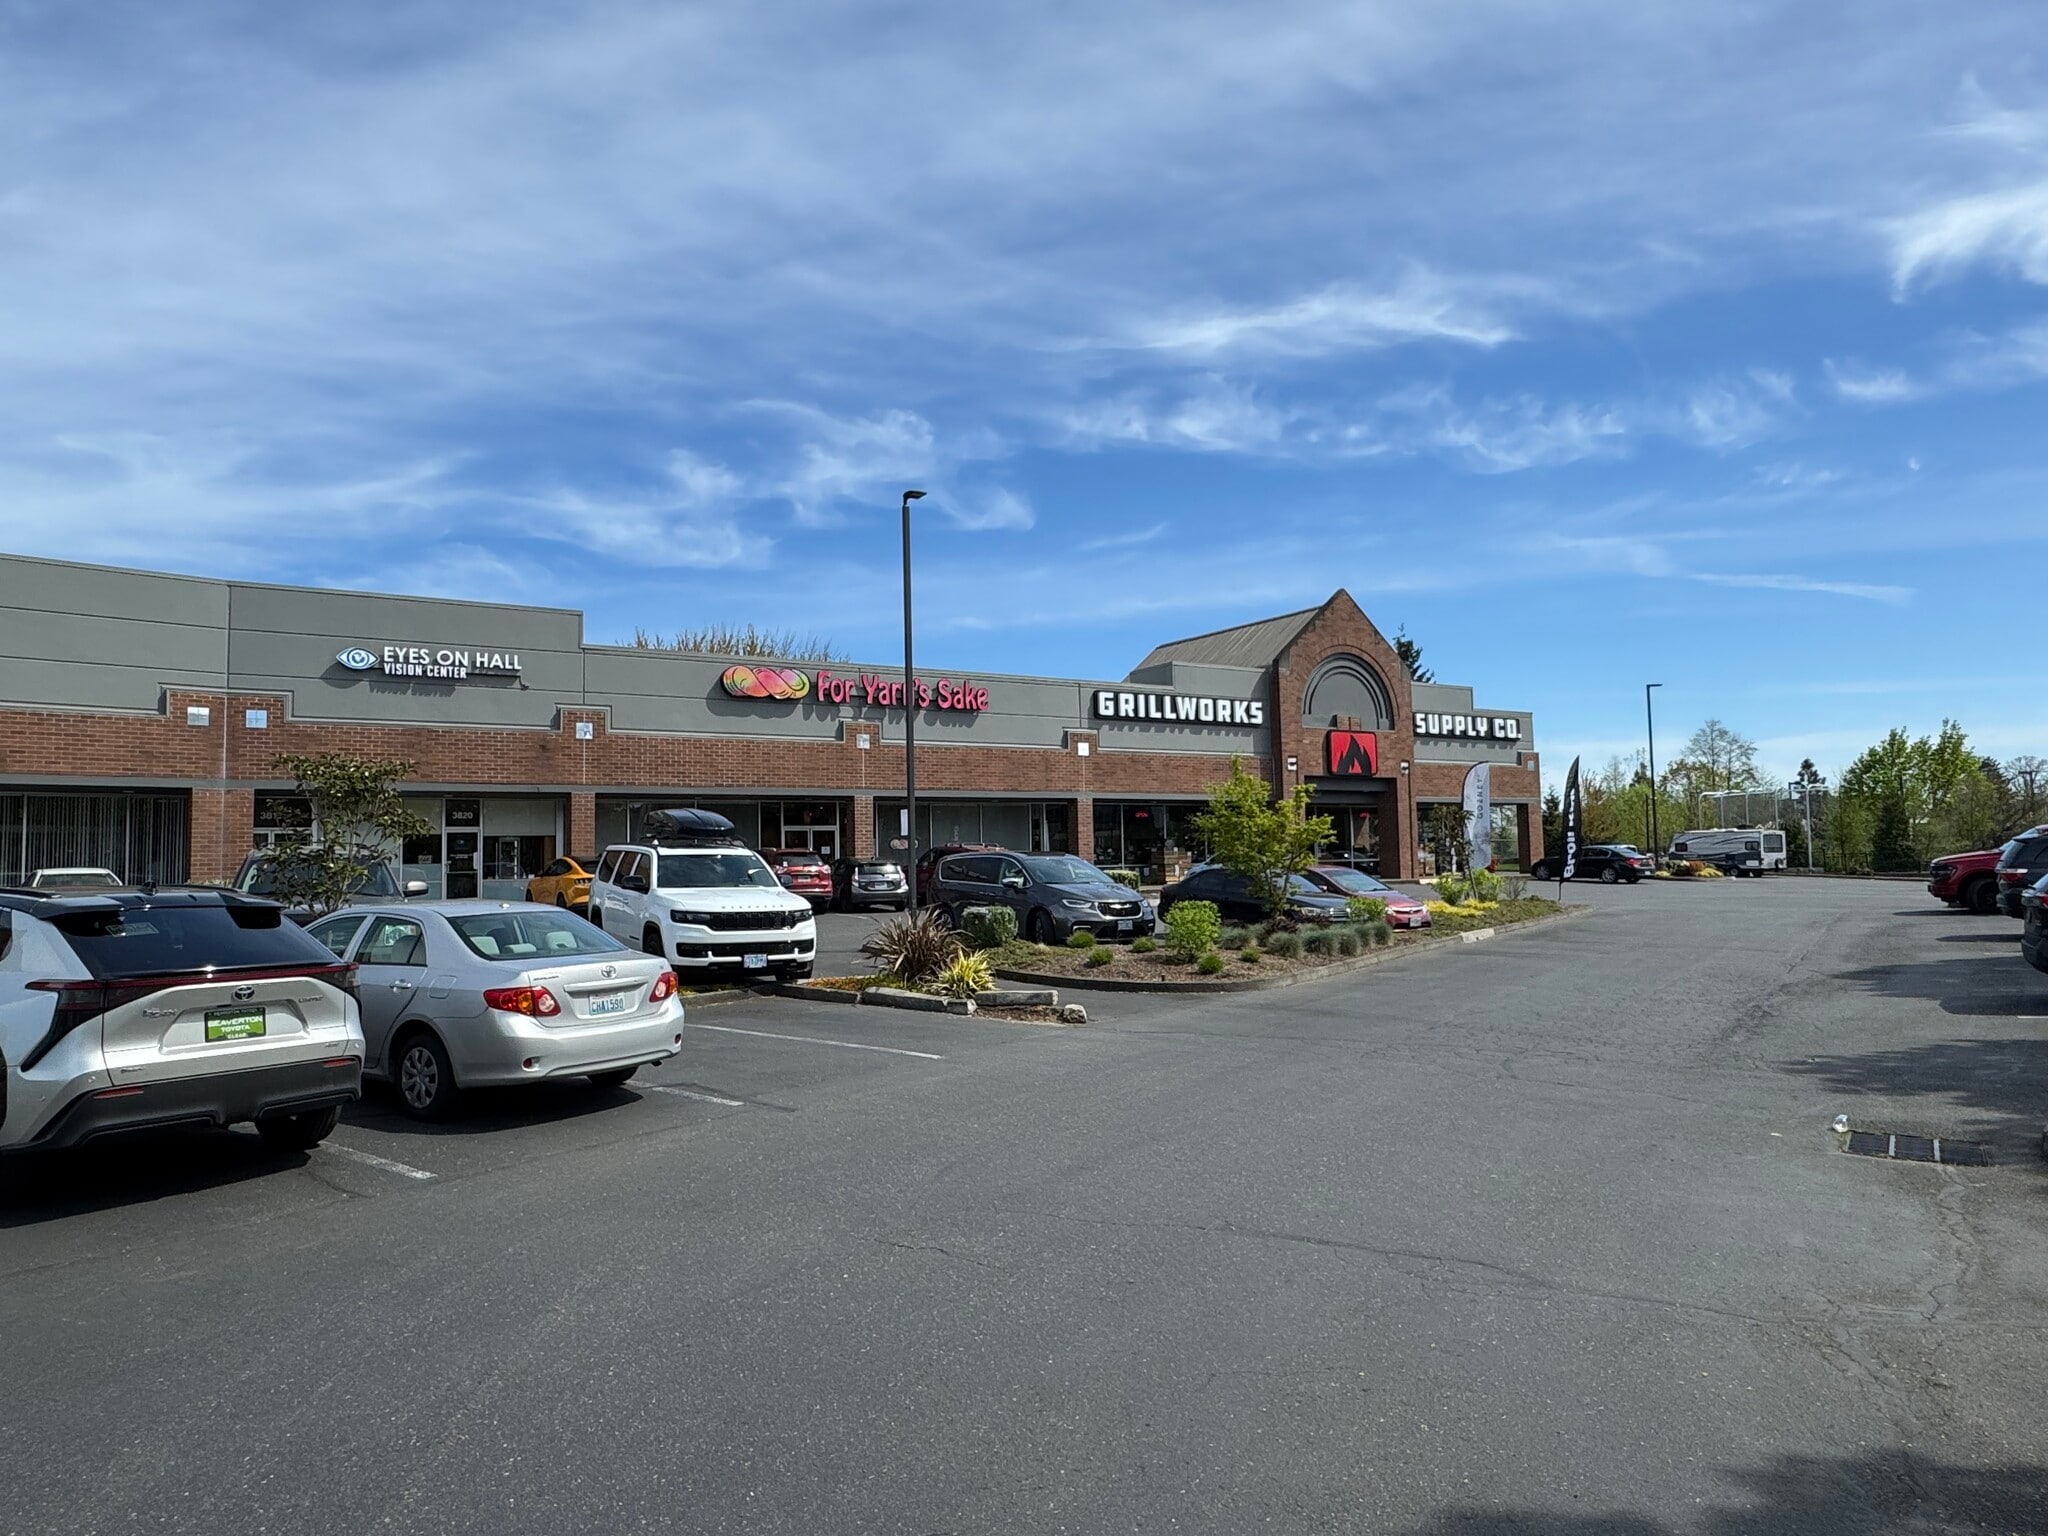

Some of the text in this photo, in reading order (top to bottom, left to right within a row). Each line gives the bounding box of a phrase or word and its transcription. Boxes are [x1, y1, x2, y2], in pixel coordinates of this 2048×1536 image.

[384, 646, 522, 670] EYES ON HALL
[384, 662, 467, 679] VISION CENTER
[816, 671, 856, 704] For
[937, 678, 990, 711] Sake
[1098, 691, 1263, 725] GRILLWORKS
[1414, 713, 1522, 739] SUPPLY CO.
[452, 811, 473, 819] 3820
[1563, 831, 1577, 879] Broil
[221, 1024, 251, 1033] TOYOTA
